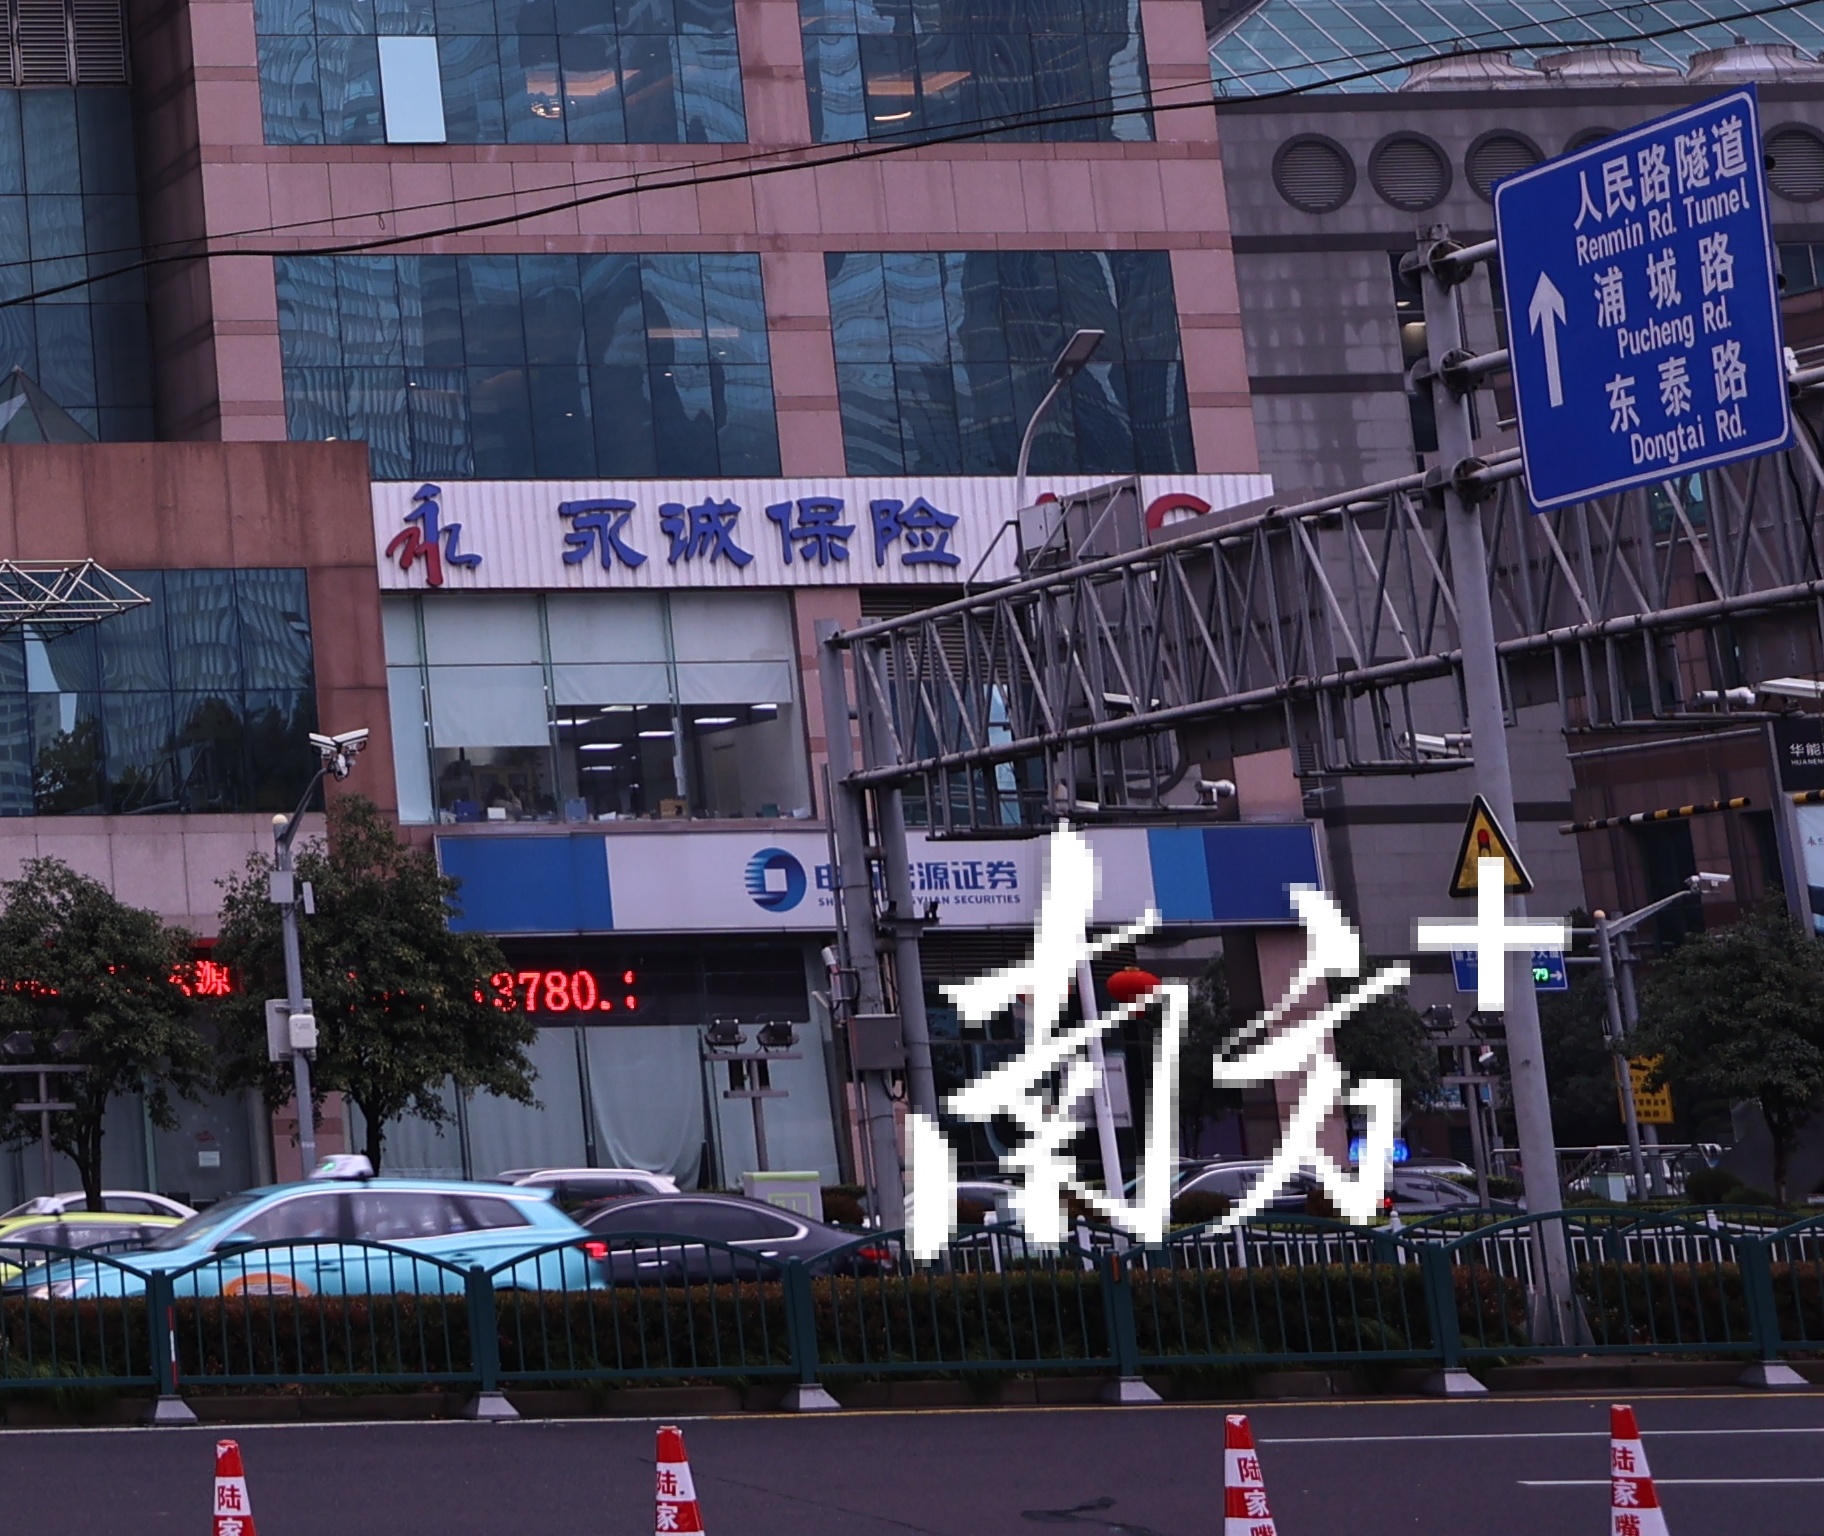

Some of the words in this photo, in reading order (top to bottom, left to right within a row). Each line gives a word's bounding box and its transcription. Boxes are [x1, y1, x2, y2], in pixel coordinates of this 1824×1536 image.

[1572, 115, 1750, 231] 人民路隧道
[1575, 221, 1645, 266] Renmin
[1650, 205, 1678, 235] Rd.
[1684, 178, 1751, 229] Tunnel
[1592, 231, 1736, 329] 浦城路
[1617, 313, 1695, 360] Pucheng
[1702, 294, 1732, 335] Rd.
[1605, 339, 1749, 434] 东泰路
[1630, 416, 1707, 466] Dongtai
[1717, 403, 1748, 439] Rd.
[560, 495, 961, 570] 永诚保险
[814, 860, 1019, 891] 申源证券
[953, 894, 1021, 905] SECURITIES
